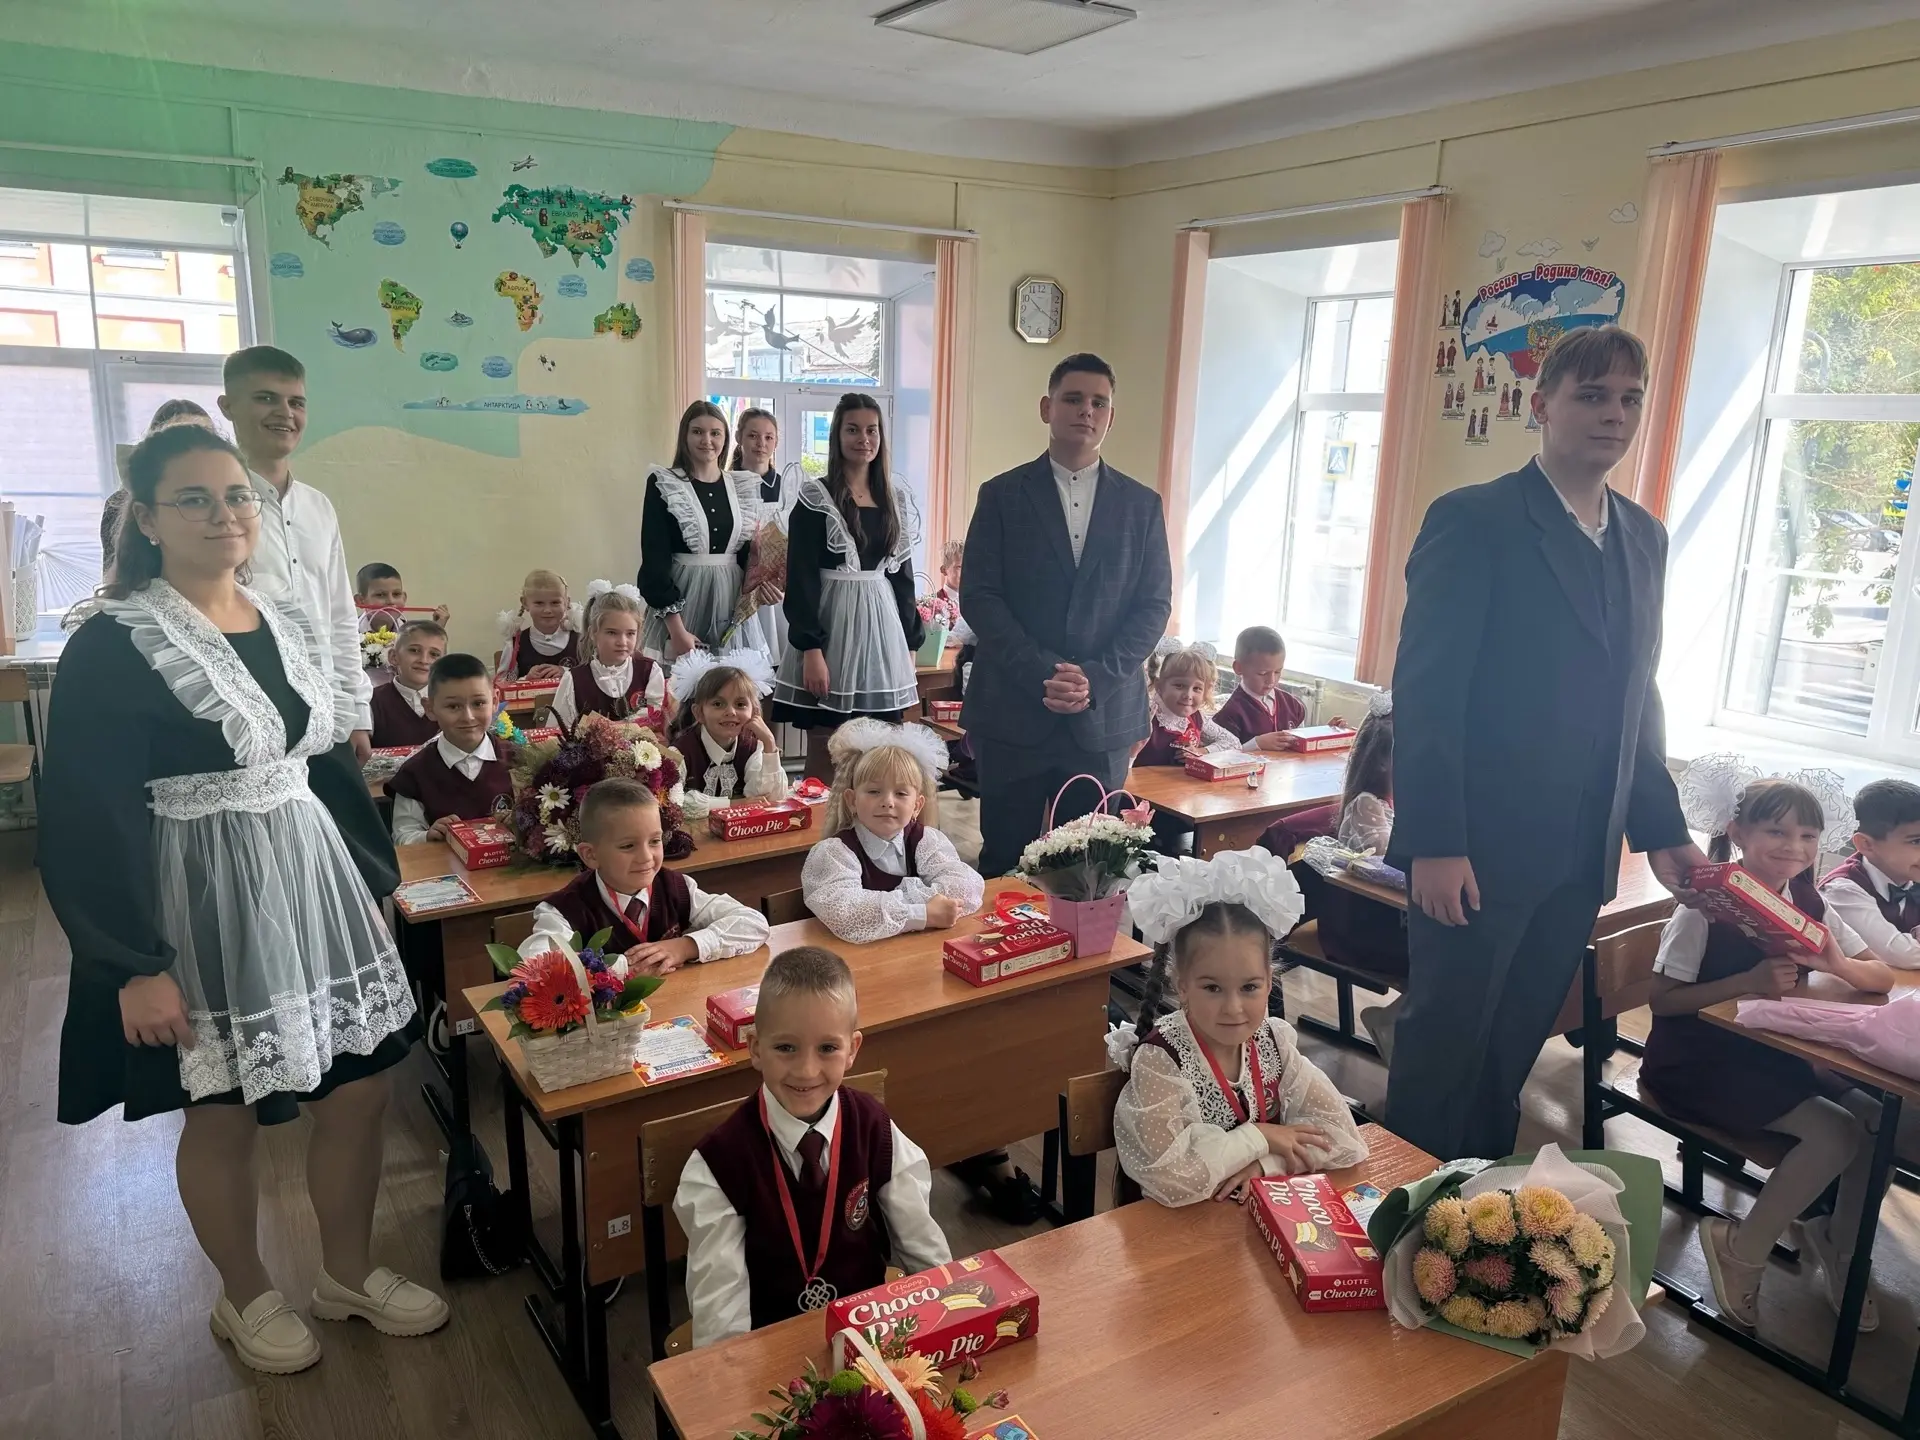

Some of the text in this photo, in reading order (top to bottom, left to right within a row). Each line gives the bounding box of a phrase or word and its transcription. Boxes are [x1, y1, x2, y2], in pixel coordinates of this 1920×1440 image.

[1479, 274, 1519, 302] Россия
[1535, 264, 1579, 282] Родина
[726, 811, 751, 819] Pie
[728, 820, 784, 838] Choco Pie
[1006, 925, 1058, 941] Choco
[1016, 920, 1044, 930] Pie
[1259, 1178, 1292, 1206] Pie
[1320, 1178, 1336, 1197] LOTTE
[1289, 1176, 1333, 1226] Choco
[610, 1220, 629, 1235] 1.8
[1249, 1196, 1286, 1267] Choco Pie
[1342, 1278, 1369, 1286] LOTTE
[844, 1291, 875, 1304] LOTTE
[1323, 1287, 1377, 1299] Choco Pie
[847, 1286, 941, 1326] Choco
[948, 1332, 985, 1361] Pie
